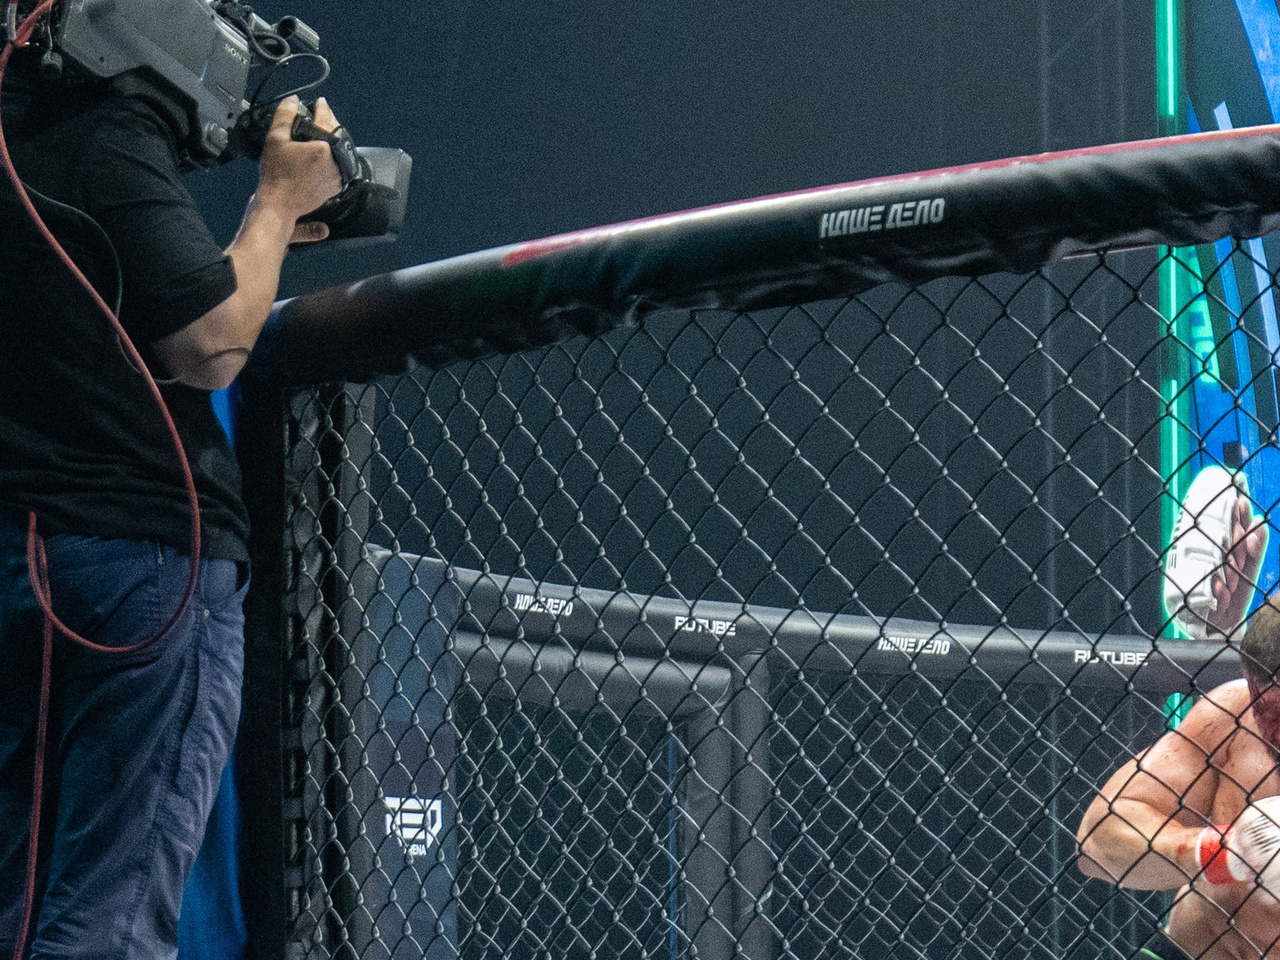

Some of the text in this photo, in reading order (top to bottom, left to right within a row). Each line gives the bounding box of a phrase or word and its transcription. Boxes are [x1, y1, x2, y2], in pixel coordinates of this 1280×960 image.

[224, 43, 248, 66] SONY
[820, 198, 946, 239] НАШЕ ДЕЛО
